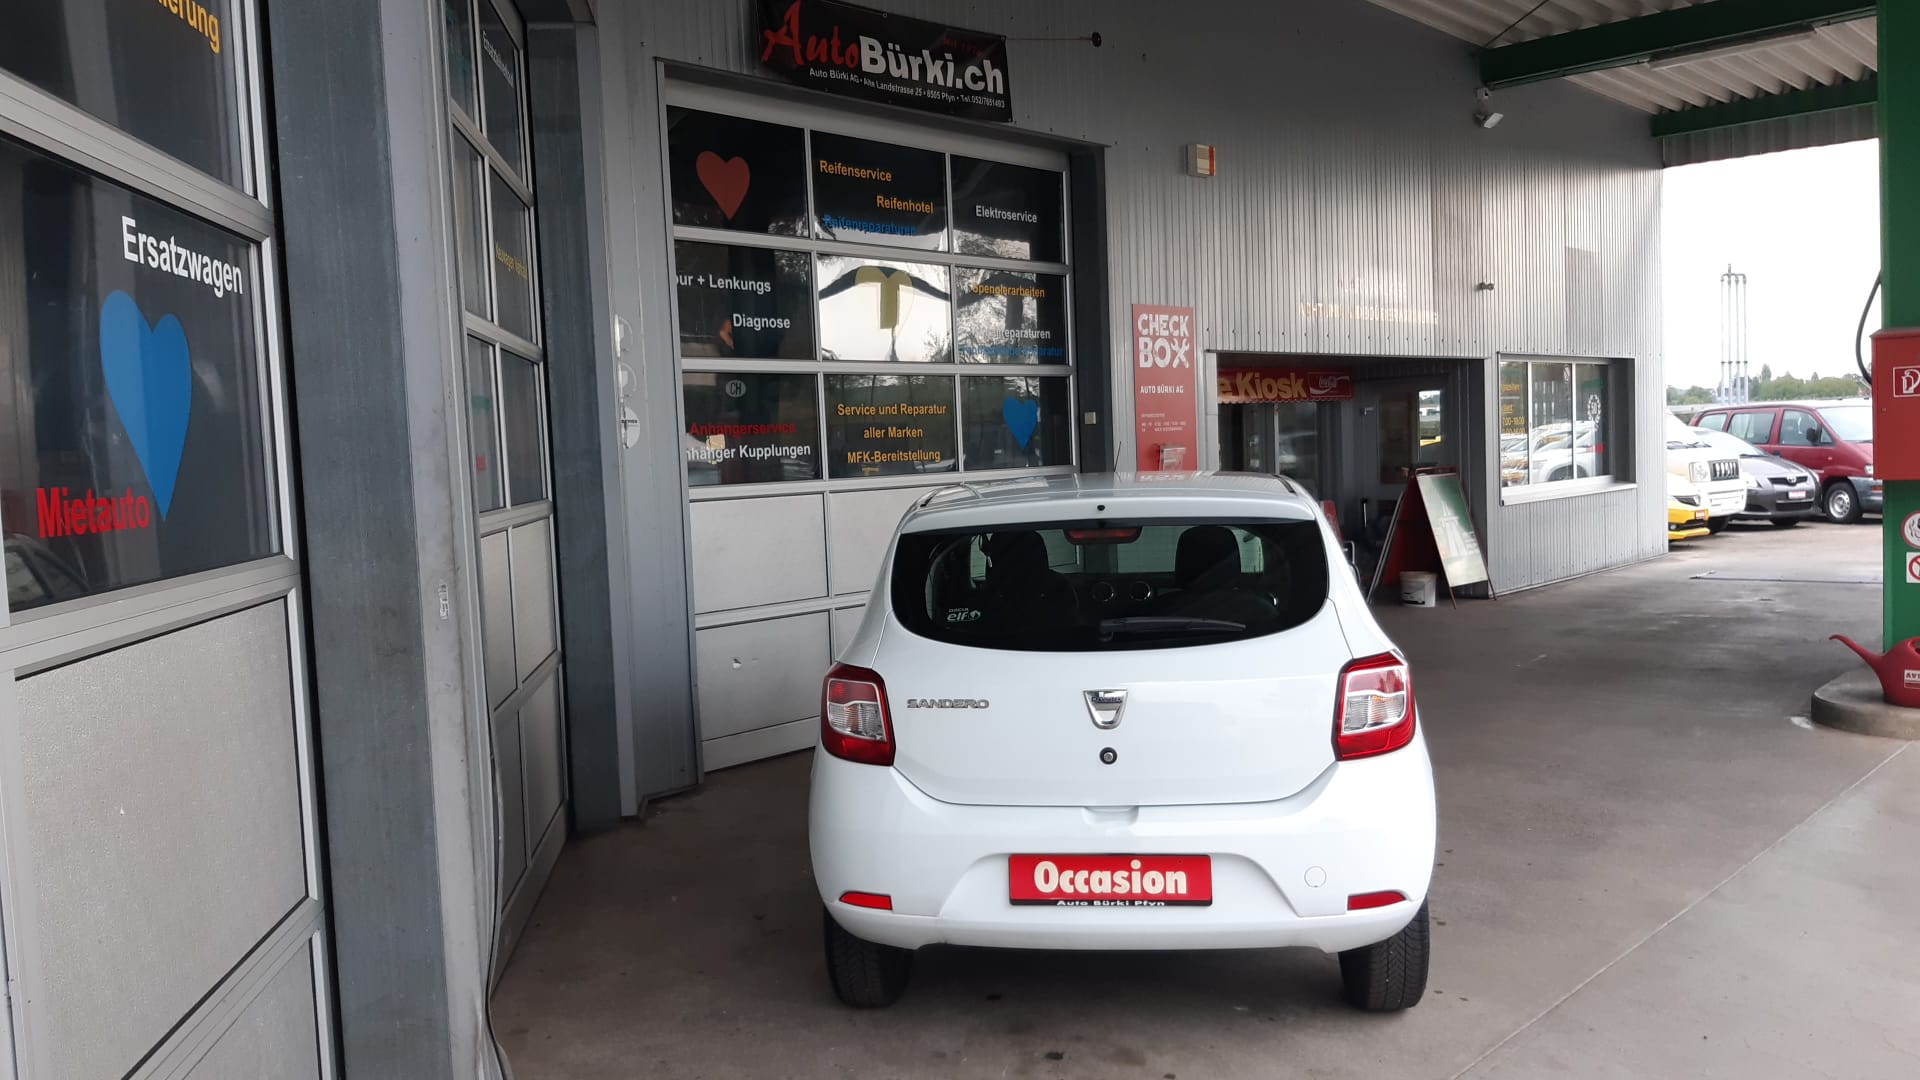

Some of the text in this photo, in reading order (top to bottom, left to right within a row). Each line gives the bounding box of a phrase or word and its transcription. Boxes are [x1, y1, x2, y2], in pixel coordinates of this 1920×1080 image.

[809, 67, 828, 79] Auto
[829, 69, 850, 82] Bürki
[850, 73, 860, 84] AG
[876, 79, 914, 96] Landstrasse
[915, 87, 923, 97] 25
[819, 159, 893, 182] Reifenservice
[876, 195, 934, 215] Reifenhotel
[975, 205, 1038, 224] Elektroservice
[121, 215, 244, 298] Ersatzwagen
[709, 274, 771, 295] Lenkungs
[733, 313, 791, 331] Diagnose
[1138, 313, 1189, 337] CHECK
[1139, 337, 1190, 368] BOX
[1140, 385, 1156, 394] AUTO
[1157, 384, 1175, 394] BÜRKI
[1236, 372, 1307, 399] Kiosk
[837, 403, 947, 417] Service und Reparatur
[864, 426, 923, 439] aller Marken
[739, 444, 811, 461] Kupplungen
[847, 450, 941, 464] MFK-Bereitstellung
[36, 487, 151, 537] Mietauto
[907, 699, 989, 709] SANDERO
[1034, 859, 1188, 895] Occasion
